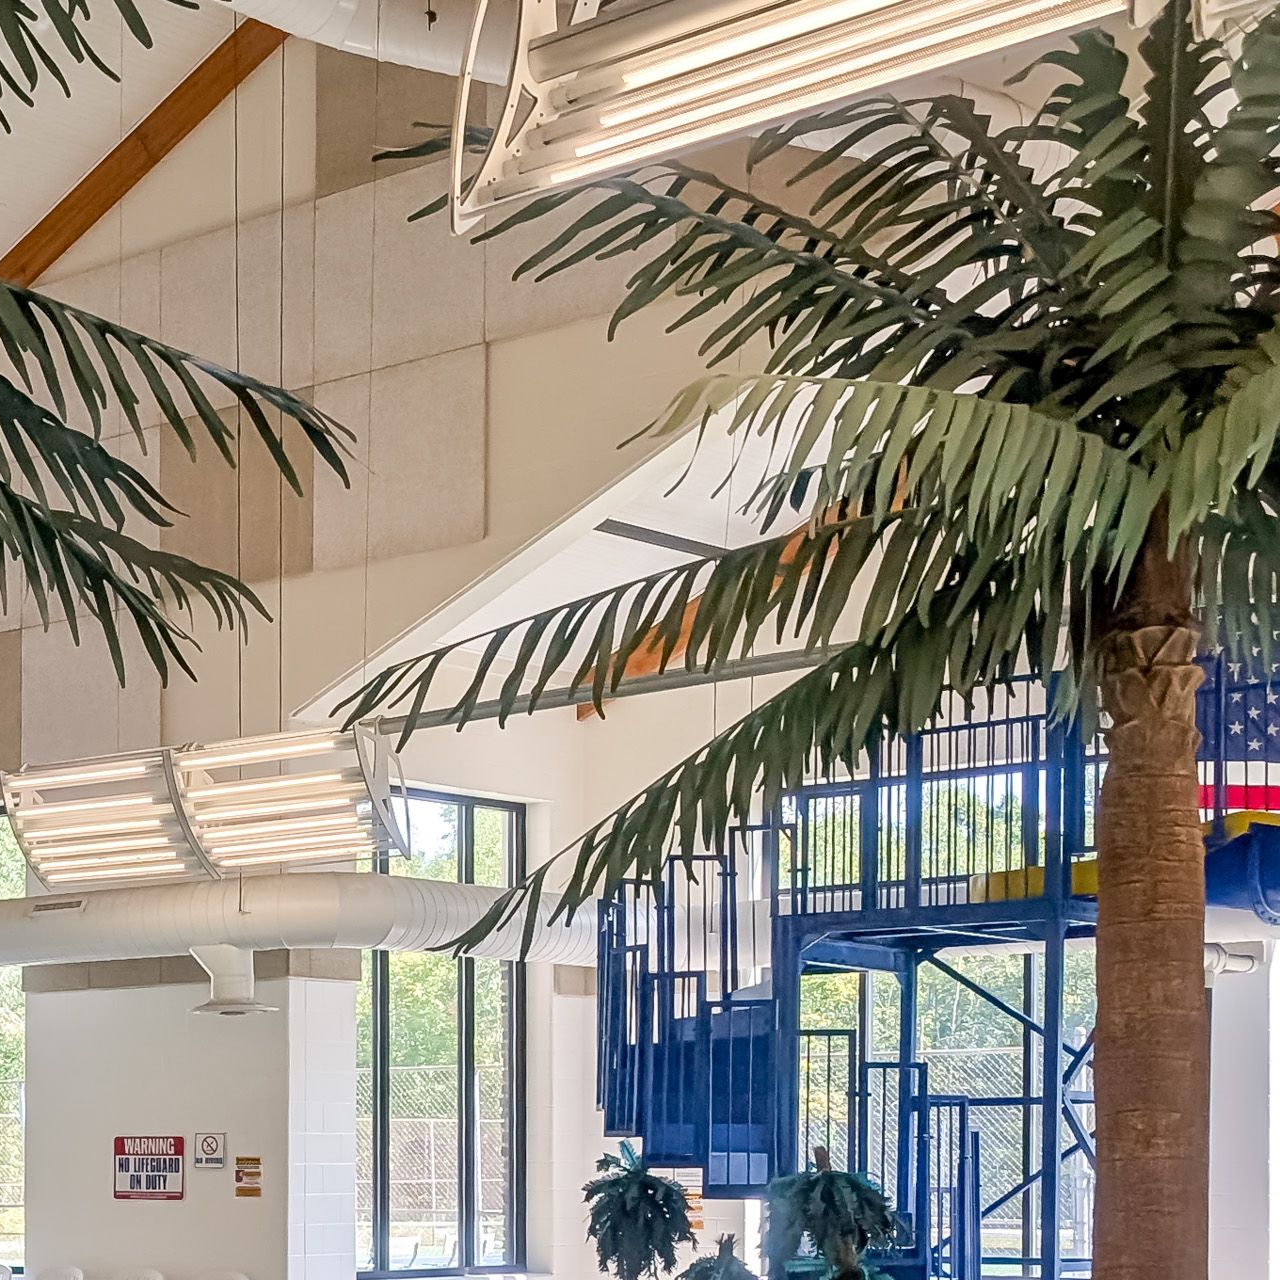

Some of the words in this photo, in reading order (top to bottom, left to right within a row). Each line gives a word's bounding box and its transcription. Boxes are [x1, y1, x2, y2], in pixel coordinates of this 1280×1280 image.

[123, 1138, 175, 1155] WARNING
[118, 1157, 130, 1174] NO
[133, 1157, 180, 1174] LIFEGUARD
[129, 1174, 141, 1190] ON
[145, 1174, 168, 1190] DUTY
